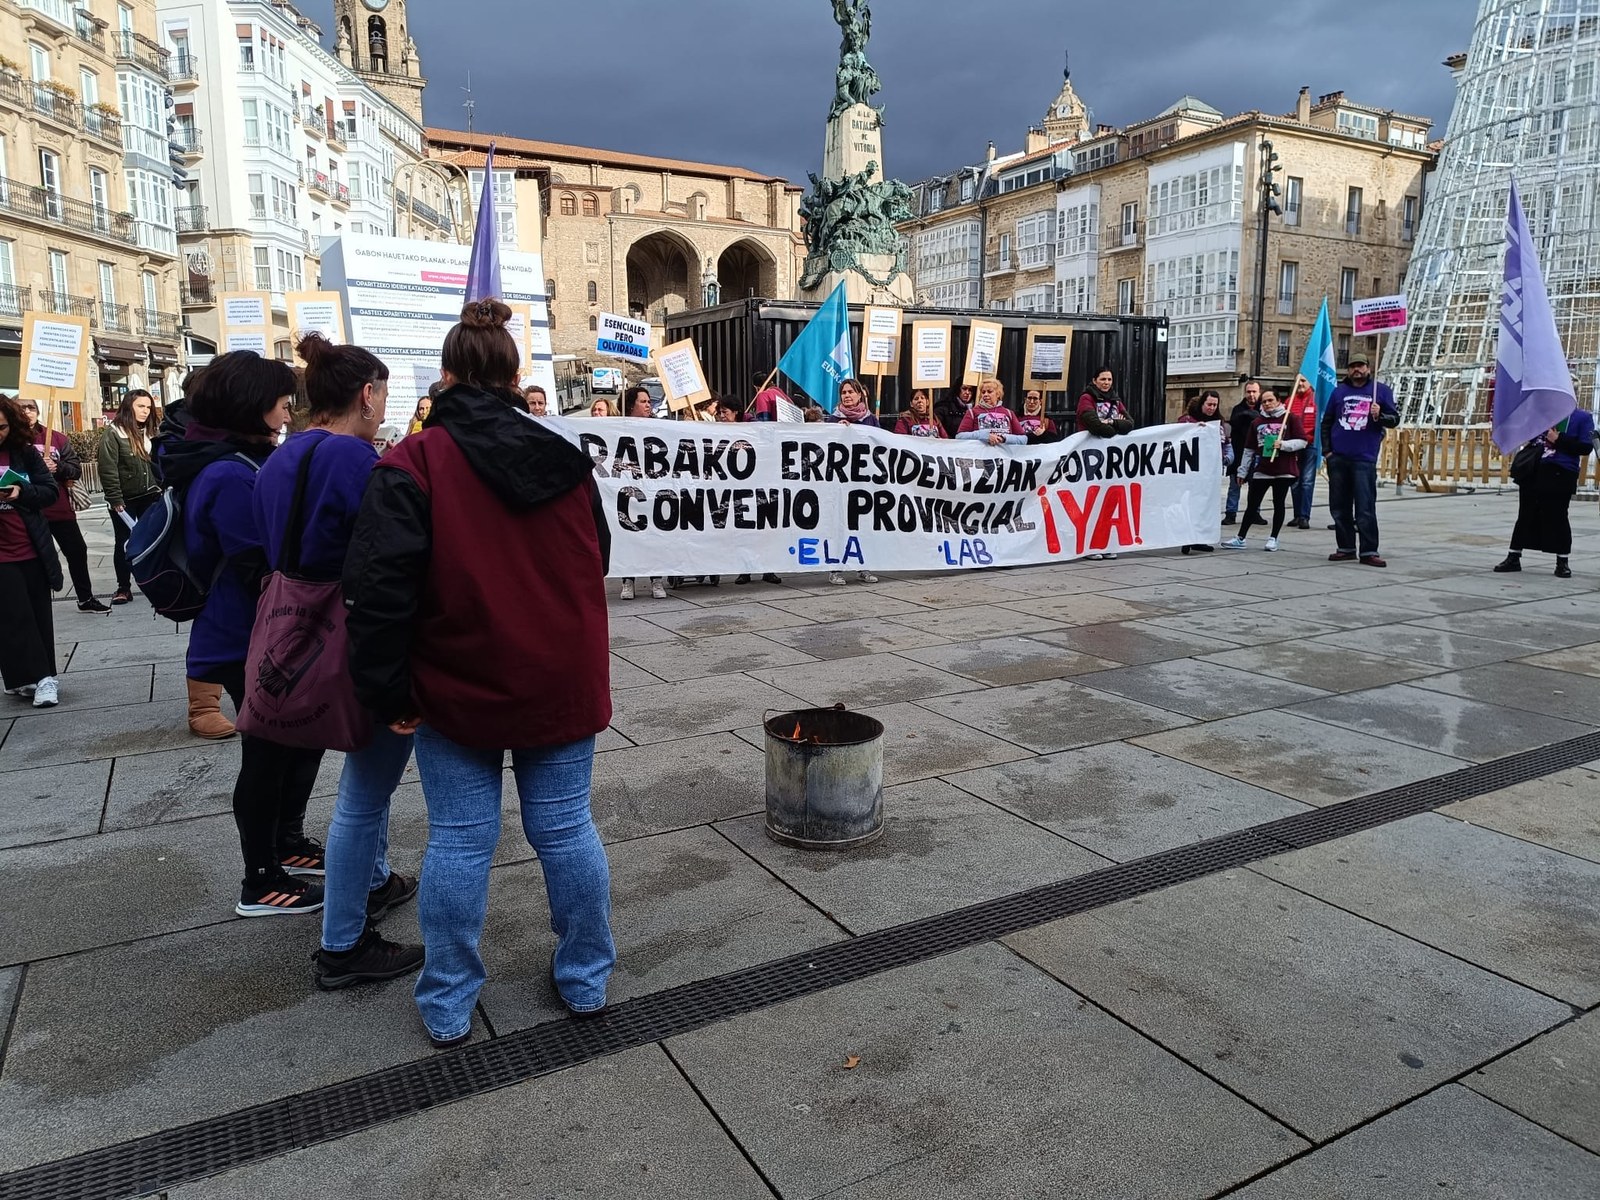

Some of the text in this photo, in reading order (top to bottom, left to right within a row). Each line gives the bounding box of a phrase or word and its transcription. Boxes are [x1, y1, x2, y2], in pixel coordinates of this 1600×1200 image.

[853, 142, 877, 154] VITORIA
[355, 248, 382, 258] GABON
[383, 251, 420, 263] HAUETAKO
[420, 256, 446, 265] PLANAK
[506, 265, 533, 273] NAVIDAD
[359, 308, 383, 317] GASTEIZ
[604, 318, 646, 336] ESENCIALES
[614, 332, 634, 344] PERO
[602, 340, 643, 357] OLVIDADAS
[781, 441, 1042, 494] ERRESIDENTZIAK
[1047, 437, 1200, 486] BORROKAN
[616, 482, 1143, 555] CONVENIO PROVINCIAL ¡YA!
